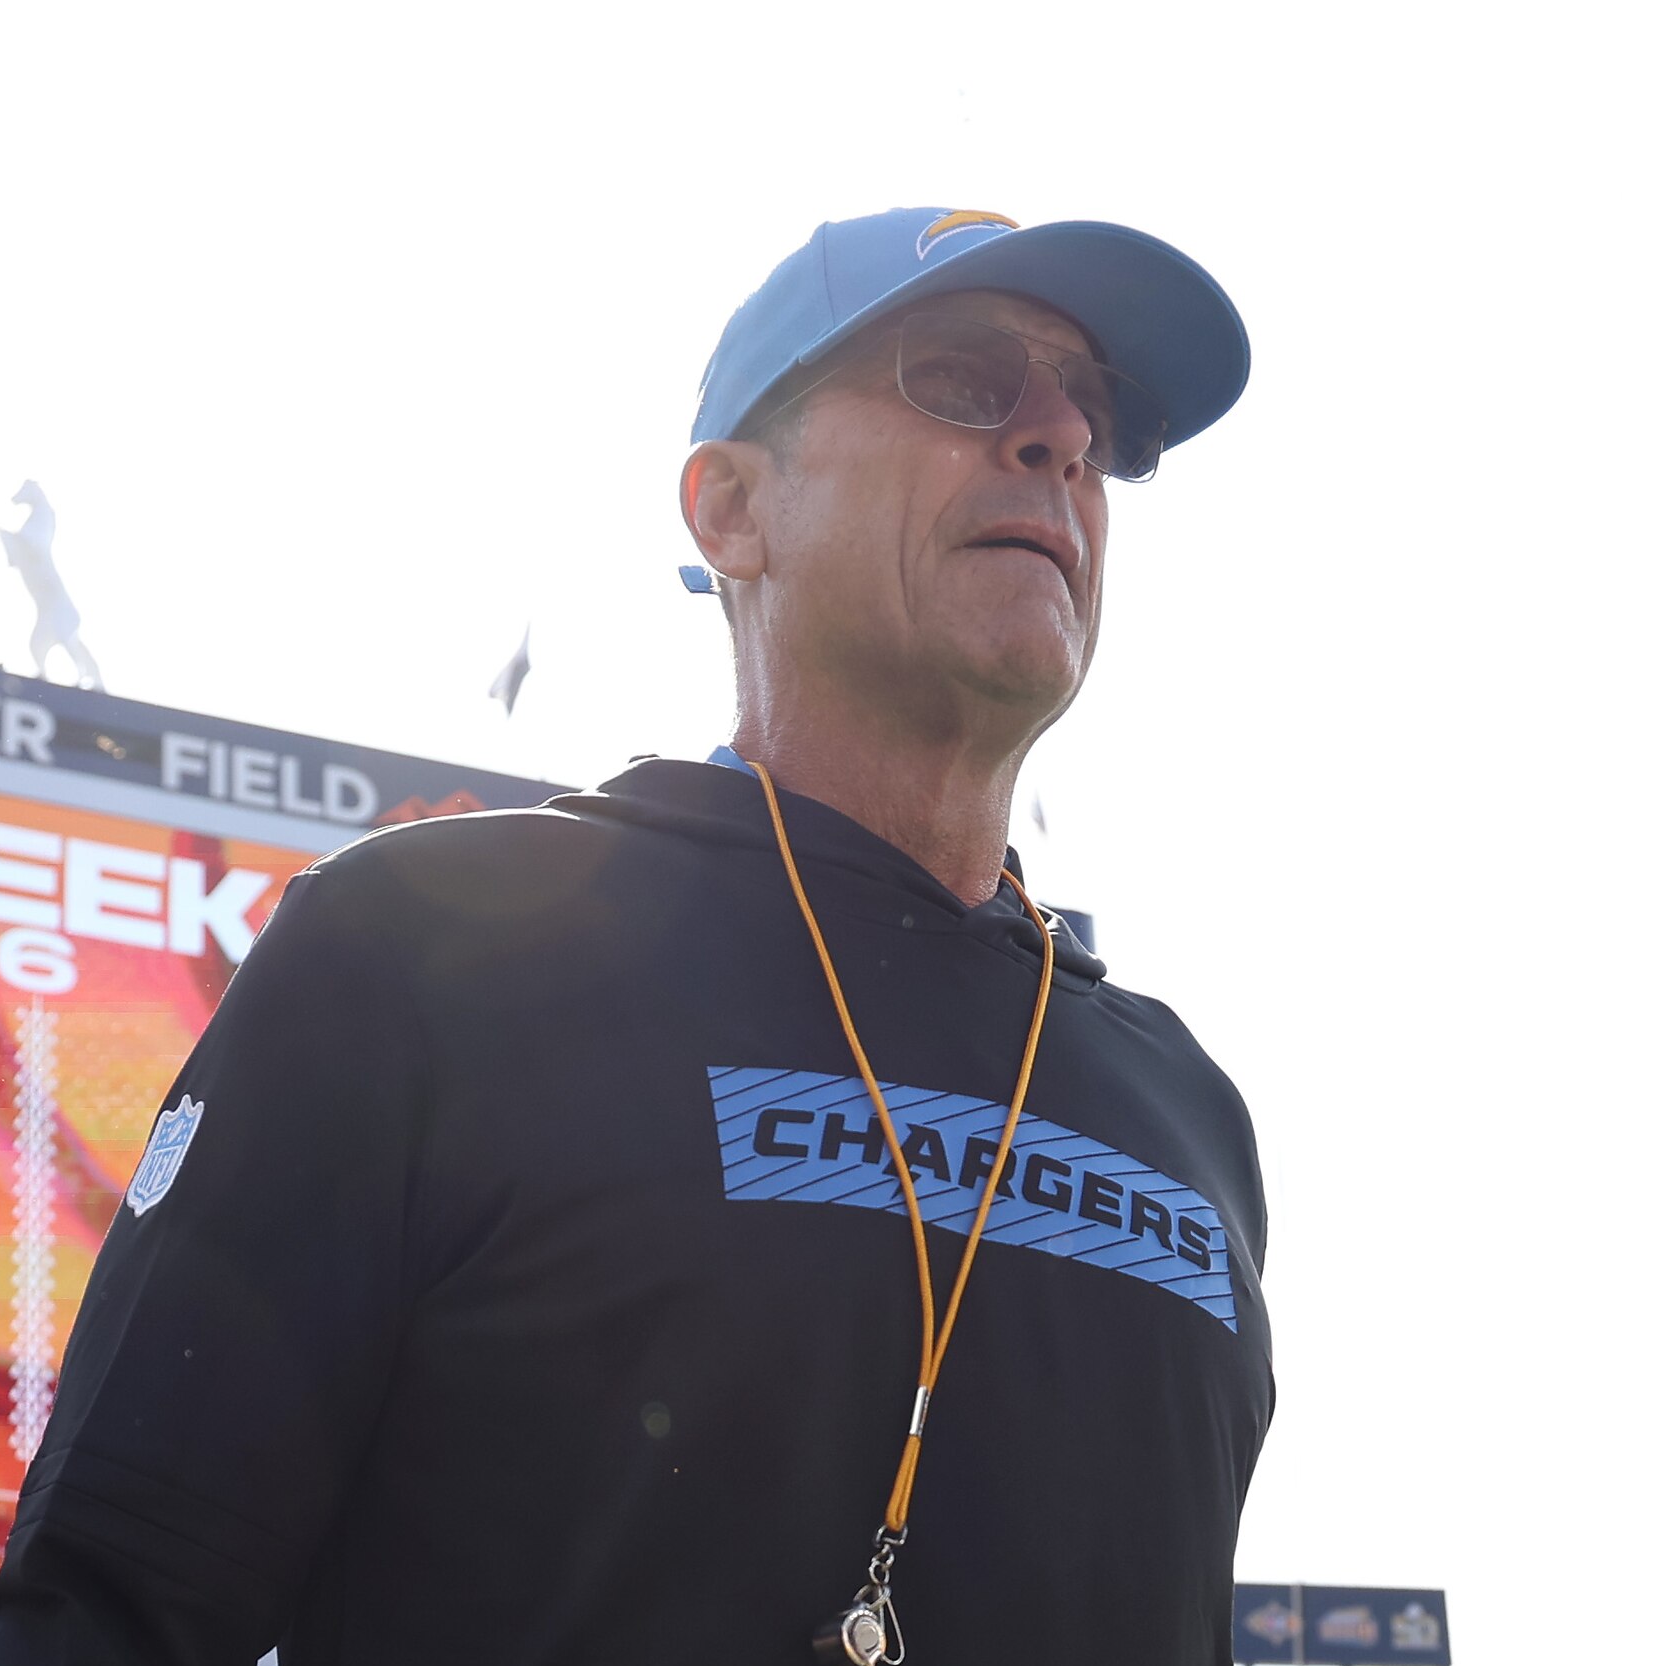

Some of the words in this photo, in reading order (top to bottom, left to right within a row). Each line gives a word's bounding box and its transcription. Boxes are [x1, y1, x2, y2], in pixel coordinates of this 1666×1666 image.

[160, 731, 379, 823] FIELD
[139, 1149, 178, 1195] NFL
[751, 1108, 1212, 1271] CHARGERS
